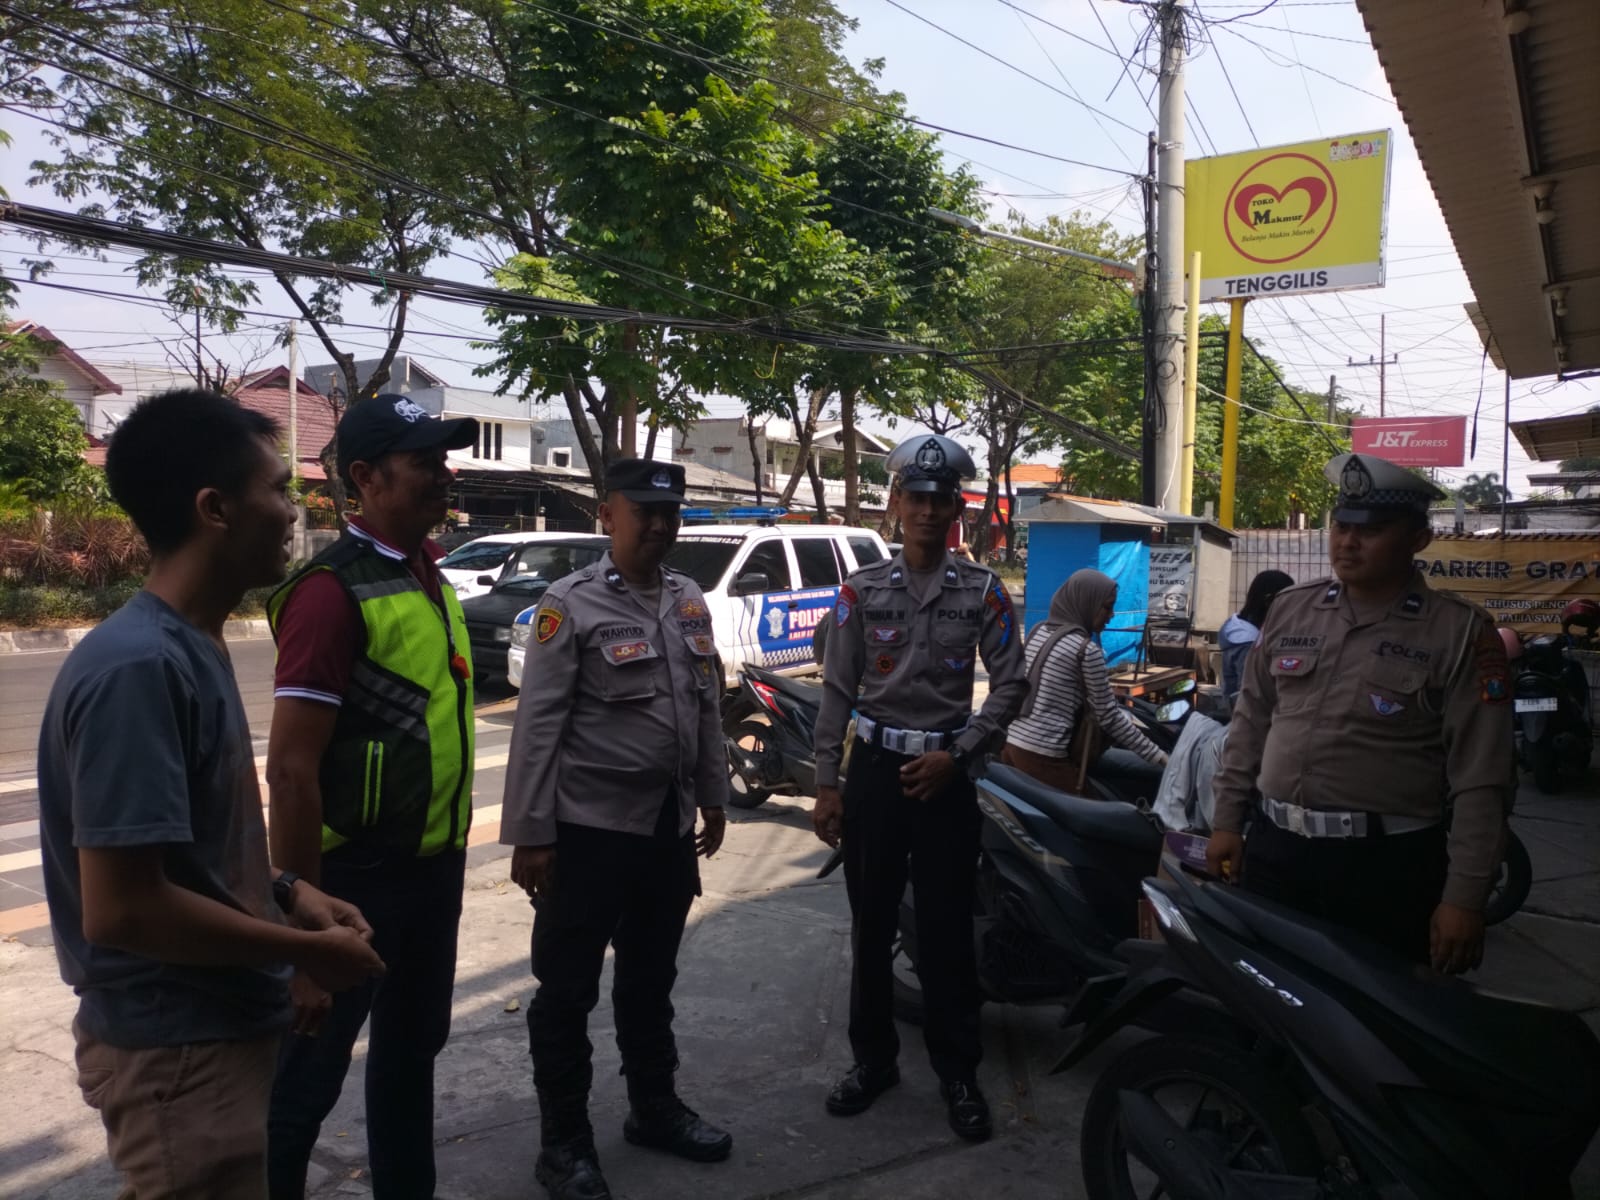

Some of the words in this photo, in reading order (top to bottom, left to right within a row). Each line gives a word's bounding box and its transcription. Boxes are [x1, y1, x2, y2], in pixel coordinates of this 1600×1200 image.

[1253, 209, 1303, 226] Makmur
[1225, 271, 1328, 295] TENGGILIS
[1367, 430, 1419, 448] J&T
[1410, 439, 1449, 448] EXPRESS
[1413, 559, 1512, 580] PARKIR
[1485, 599, 1532, 610] KHUSUS
[788, 607, 831, 630] POLIS
[937, 609, 980, 621] POLRI
[681, 619, 708, 631] POLR
[1280, 637, 1319, 648] DIMAS
[1380, 640, 1433, 663] POLRI
